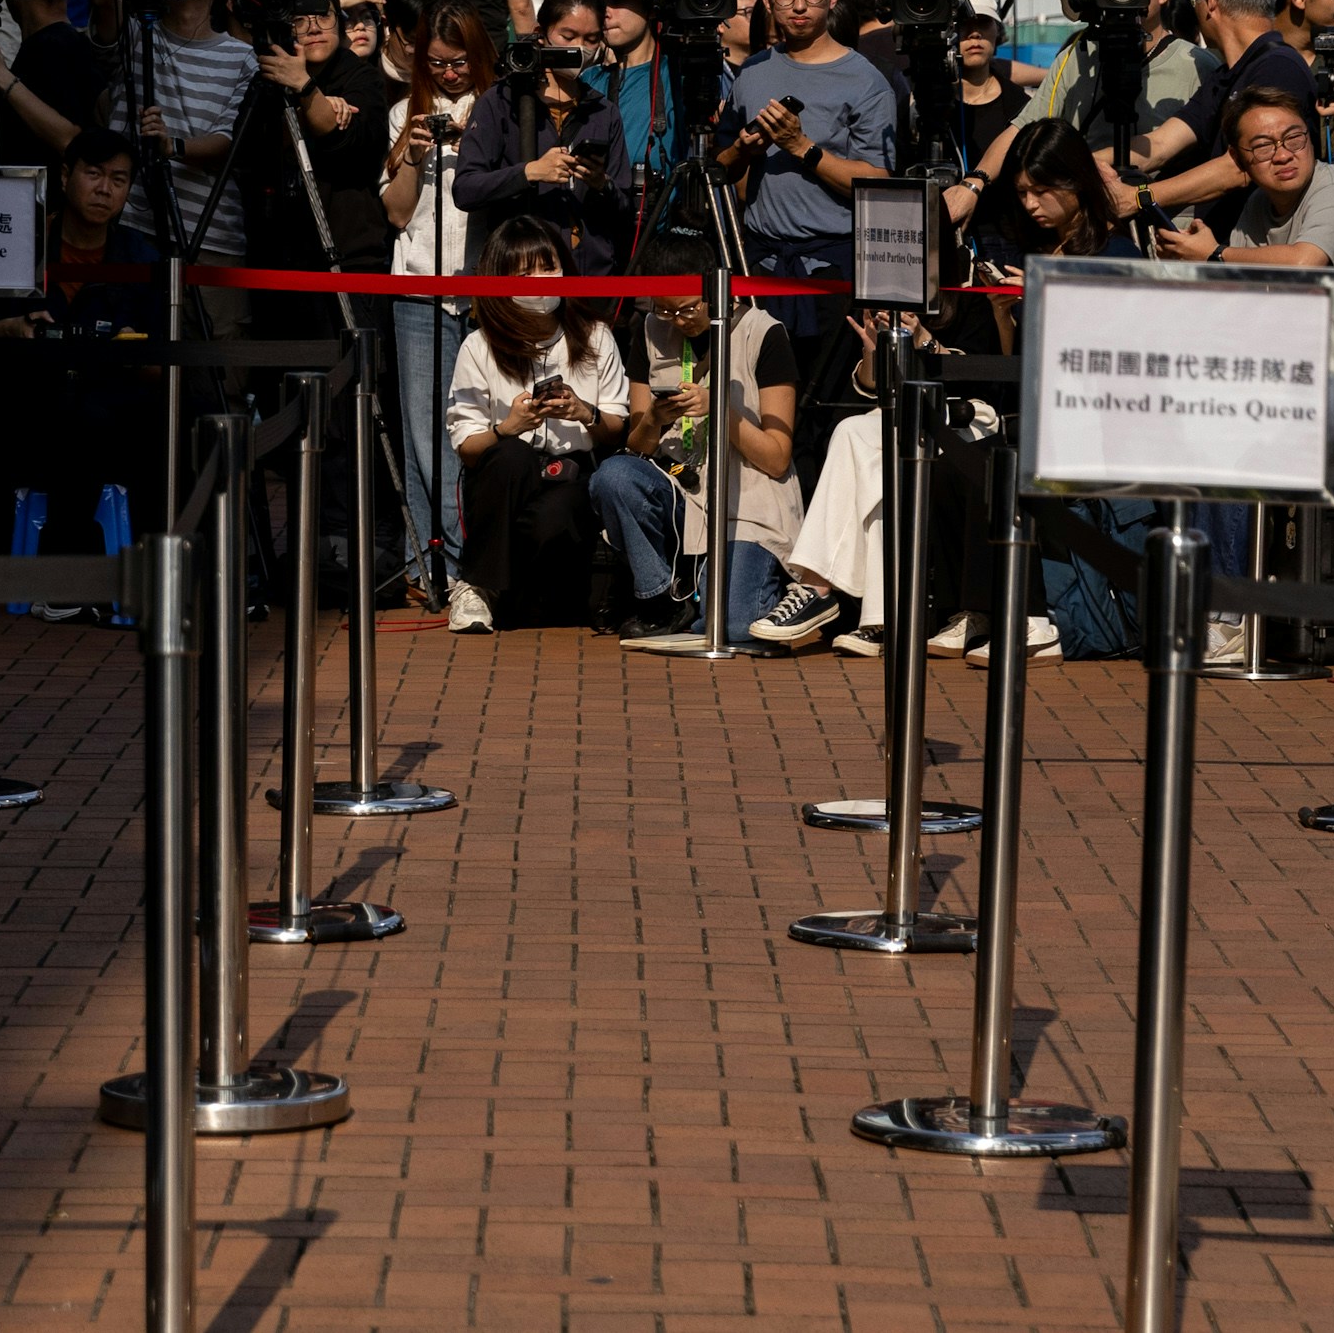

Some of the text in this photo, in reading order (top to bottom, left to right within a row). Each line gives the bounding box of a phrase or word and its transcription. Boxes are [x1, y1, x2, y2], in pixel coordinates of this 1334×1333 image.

[887, 252, 906, 264] Parties
[1058, 348, 1315, 385] 相關團體代表排隊處
[1054, 389, 1317, 422] Involved Parties Queue
